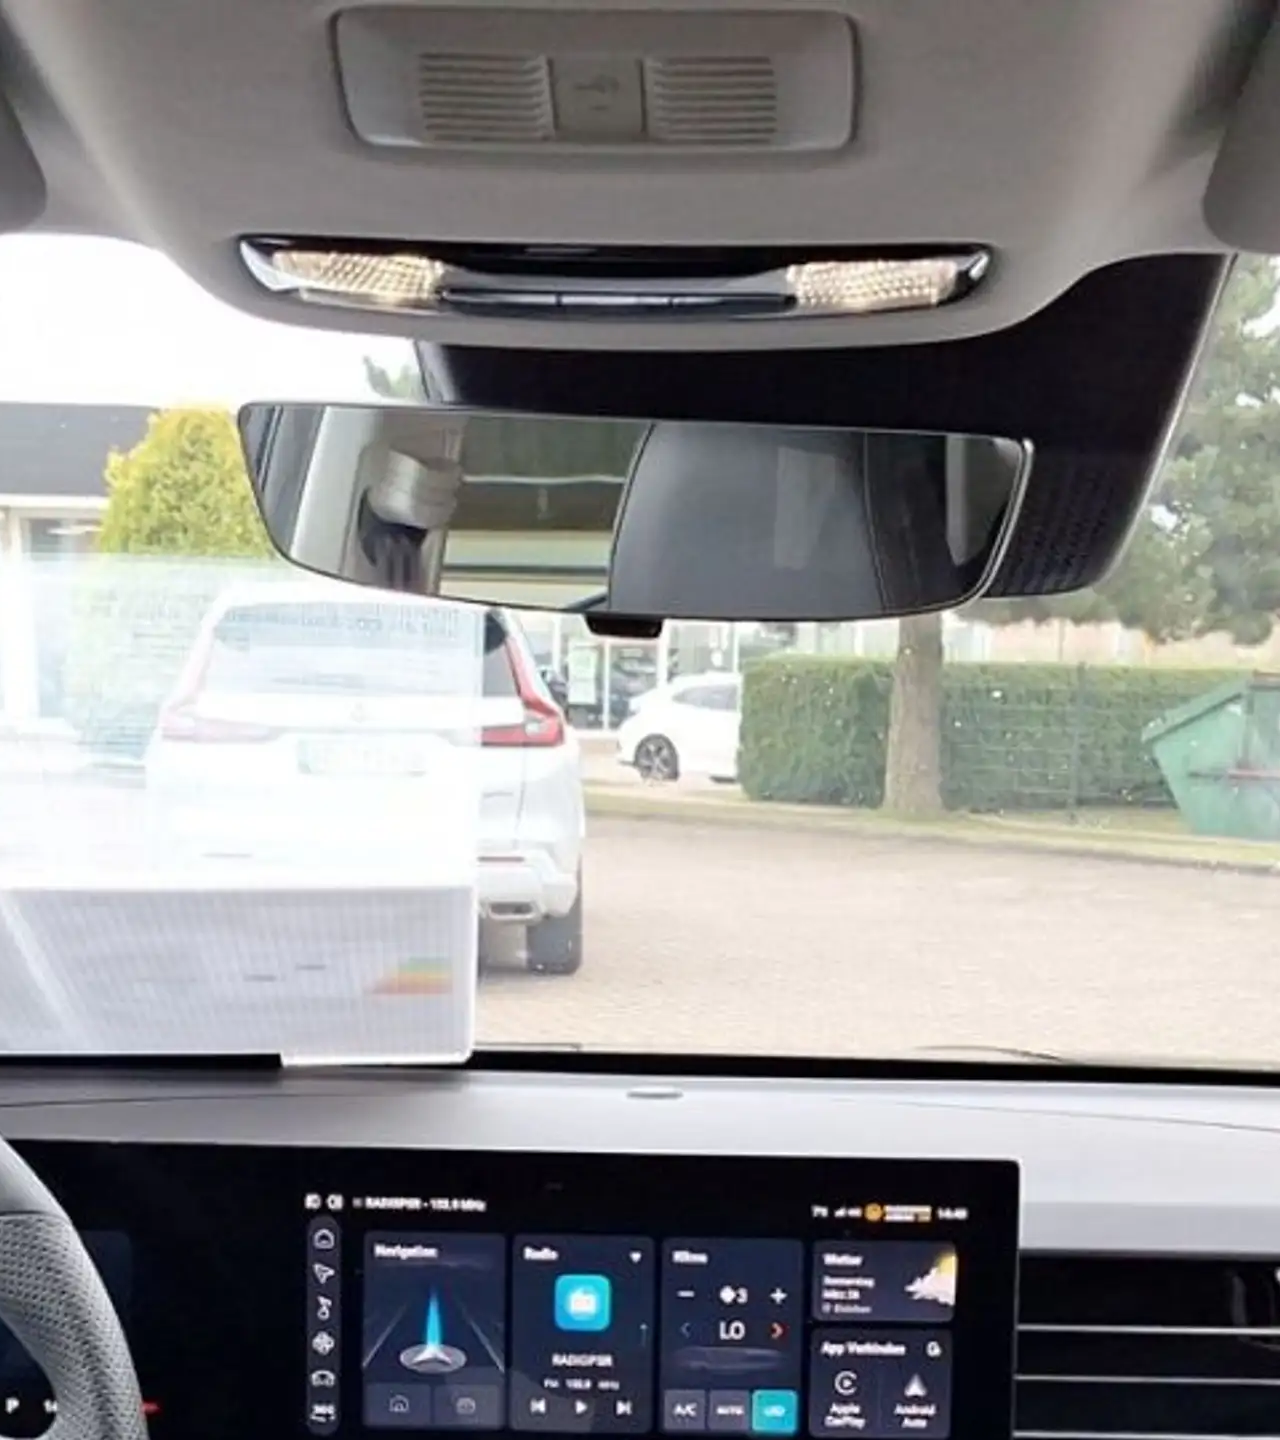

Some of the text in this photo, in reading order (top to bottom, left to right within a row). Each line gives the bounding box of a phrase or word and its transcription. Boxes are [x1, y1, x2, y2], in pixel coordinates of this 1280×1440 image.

[373, 1243, 438, 1260] Navigation
[523, 1246, 559, 1260] Radio
[719, 1320, 746, 1340] LO
[821, 1341, 845, 1357] App
[830, 1402, 861, 1416] Apple
[894, 1403, 937, 1417] Android
[824, 1415, 867, 1430] CarPlay
[901, 1417, 928, 1429] Auto
